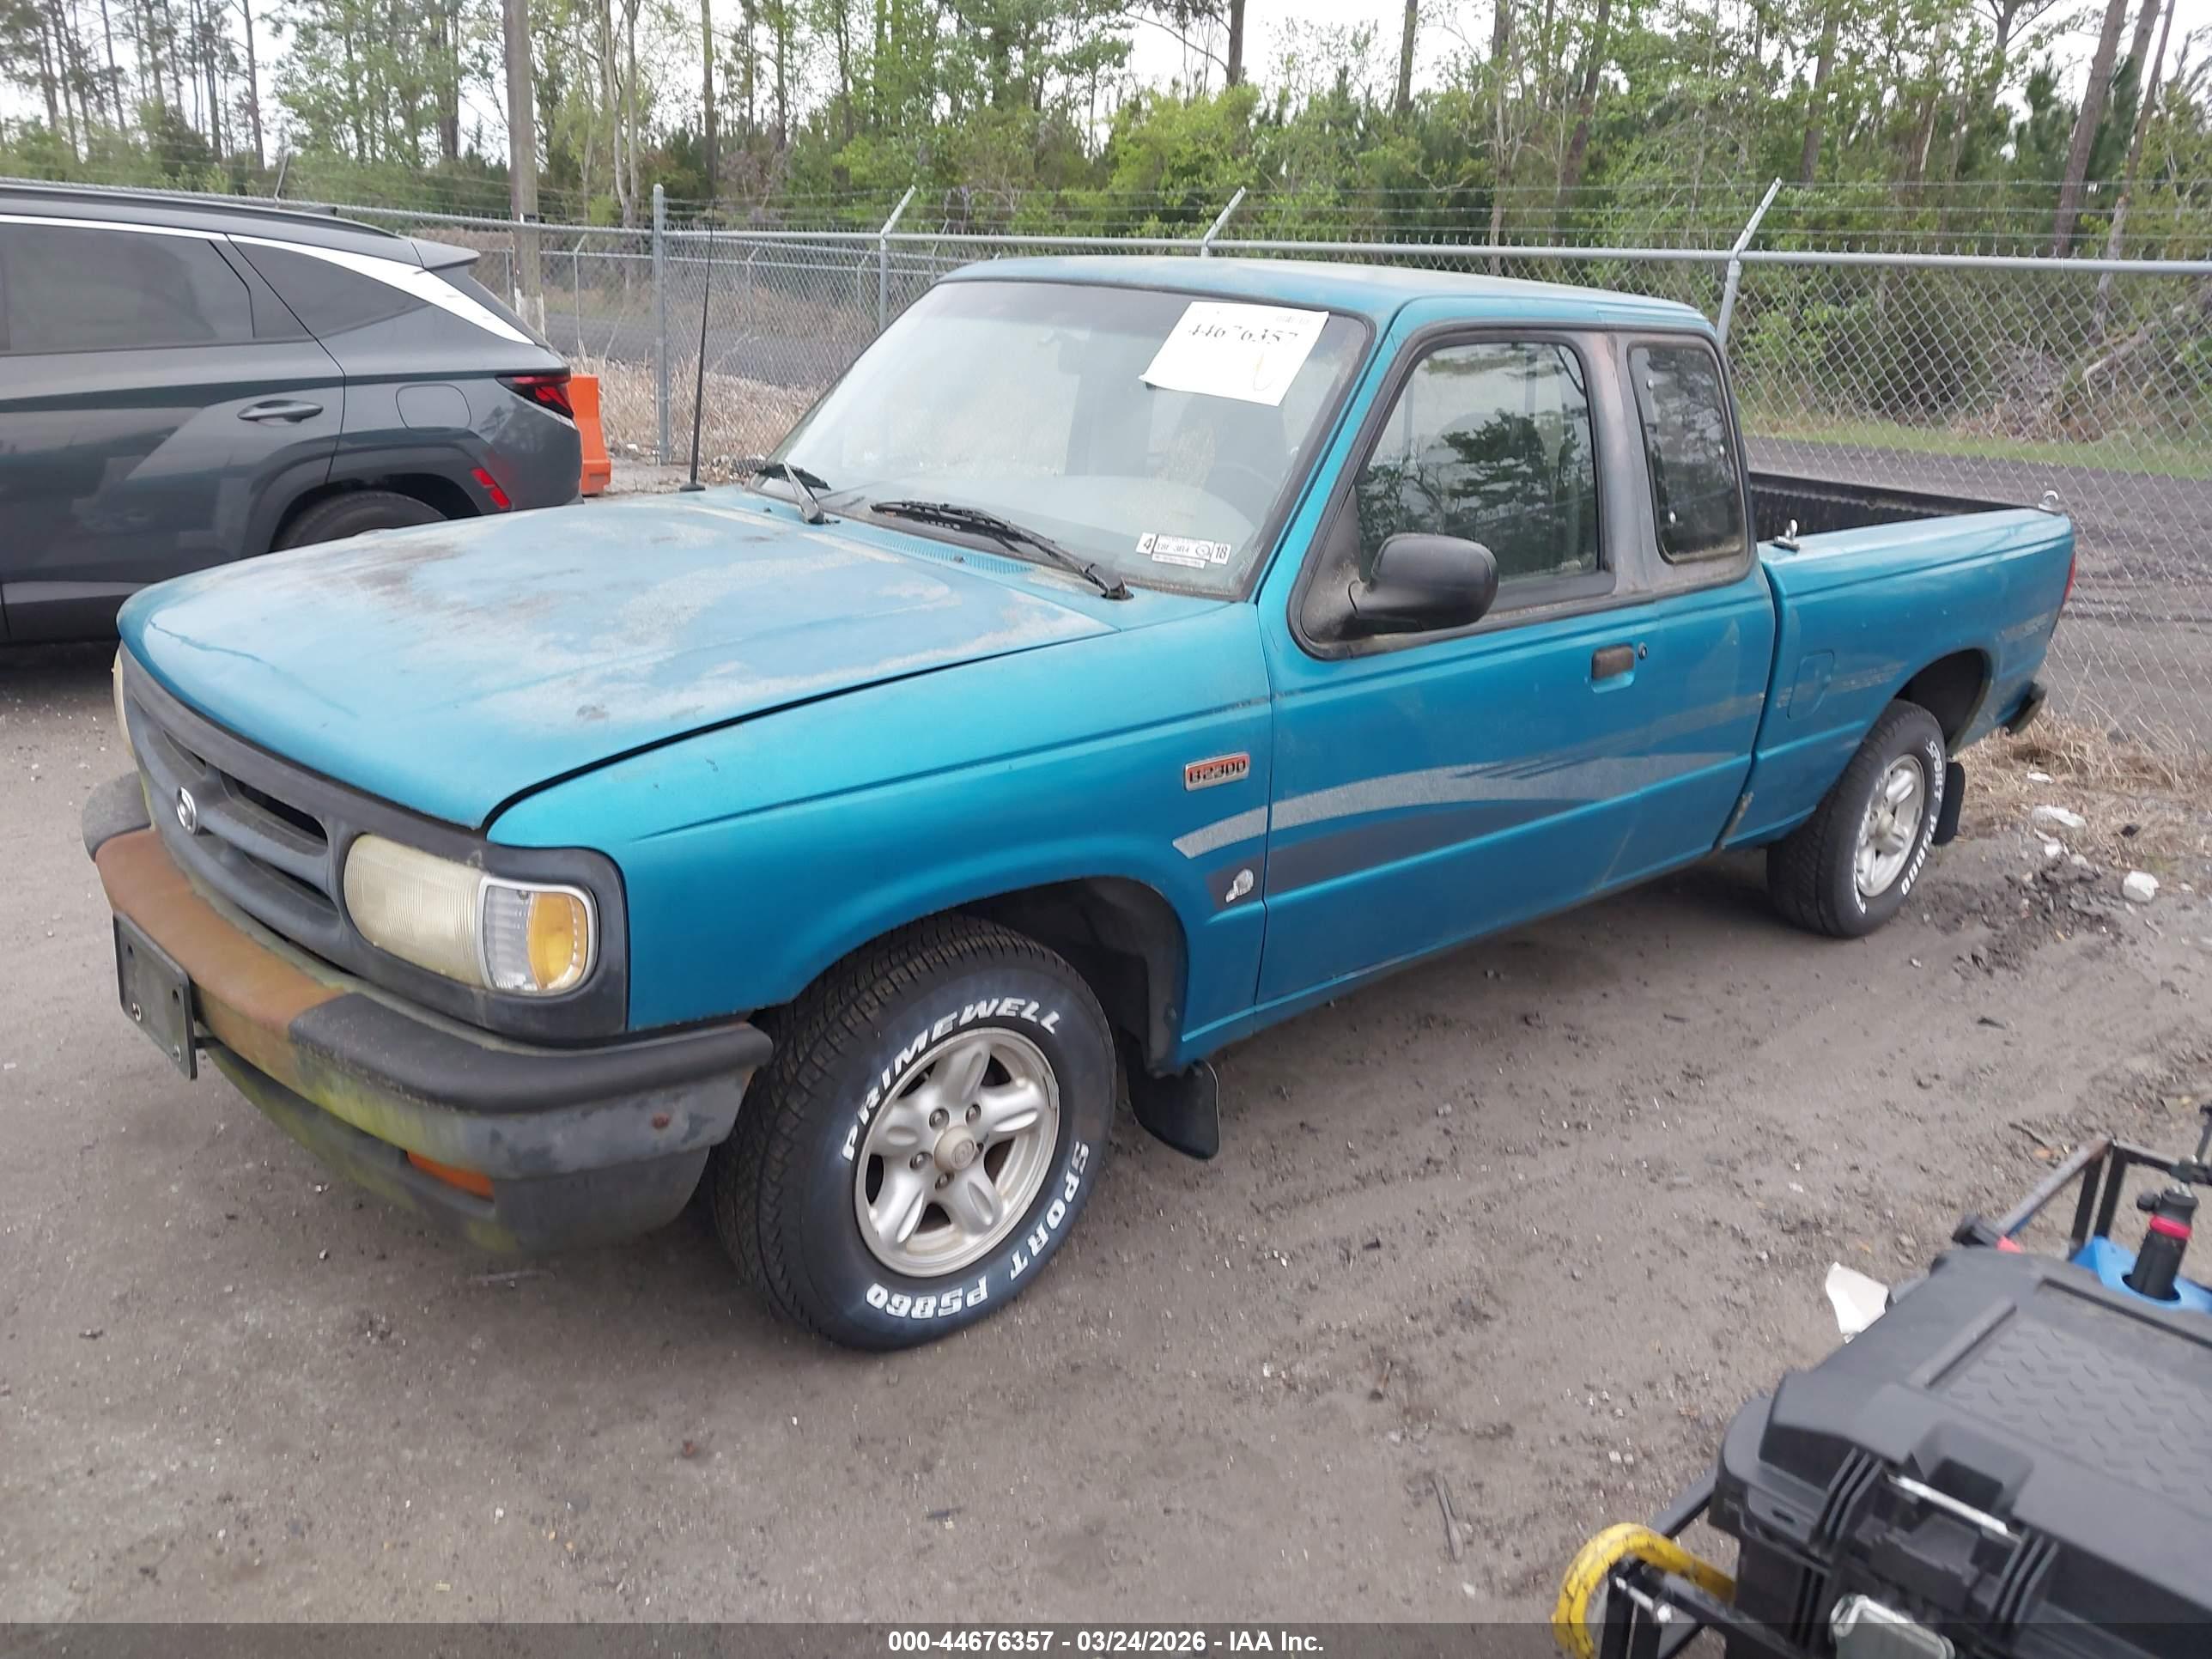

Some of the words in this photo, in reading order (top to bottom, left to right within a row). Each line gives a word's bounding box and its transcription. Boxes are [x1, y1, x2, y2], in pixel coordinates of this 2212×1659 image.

[1143, 538, 1153, 550] 4
[1214, 545, 1229, 559] 18
[840, 996, 1065, 1163] PRIMEWELL
[1009, 1140, 1091, 1282] SPORT
[865, 1275, 989, 1320] PS860
